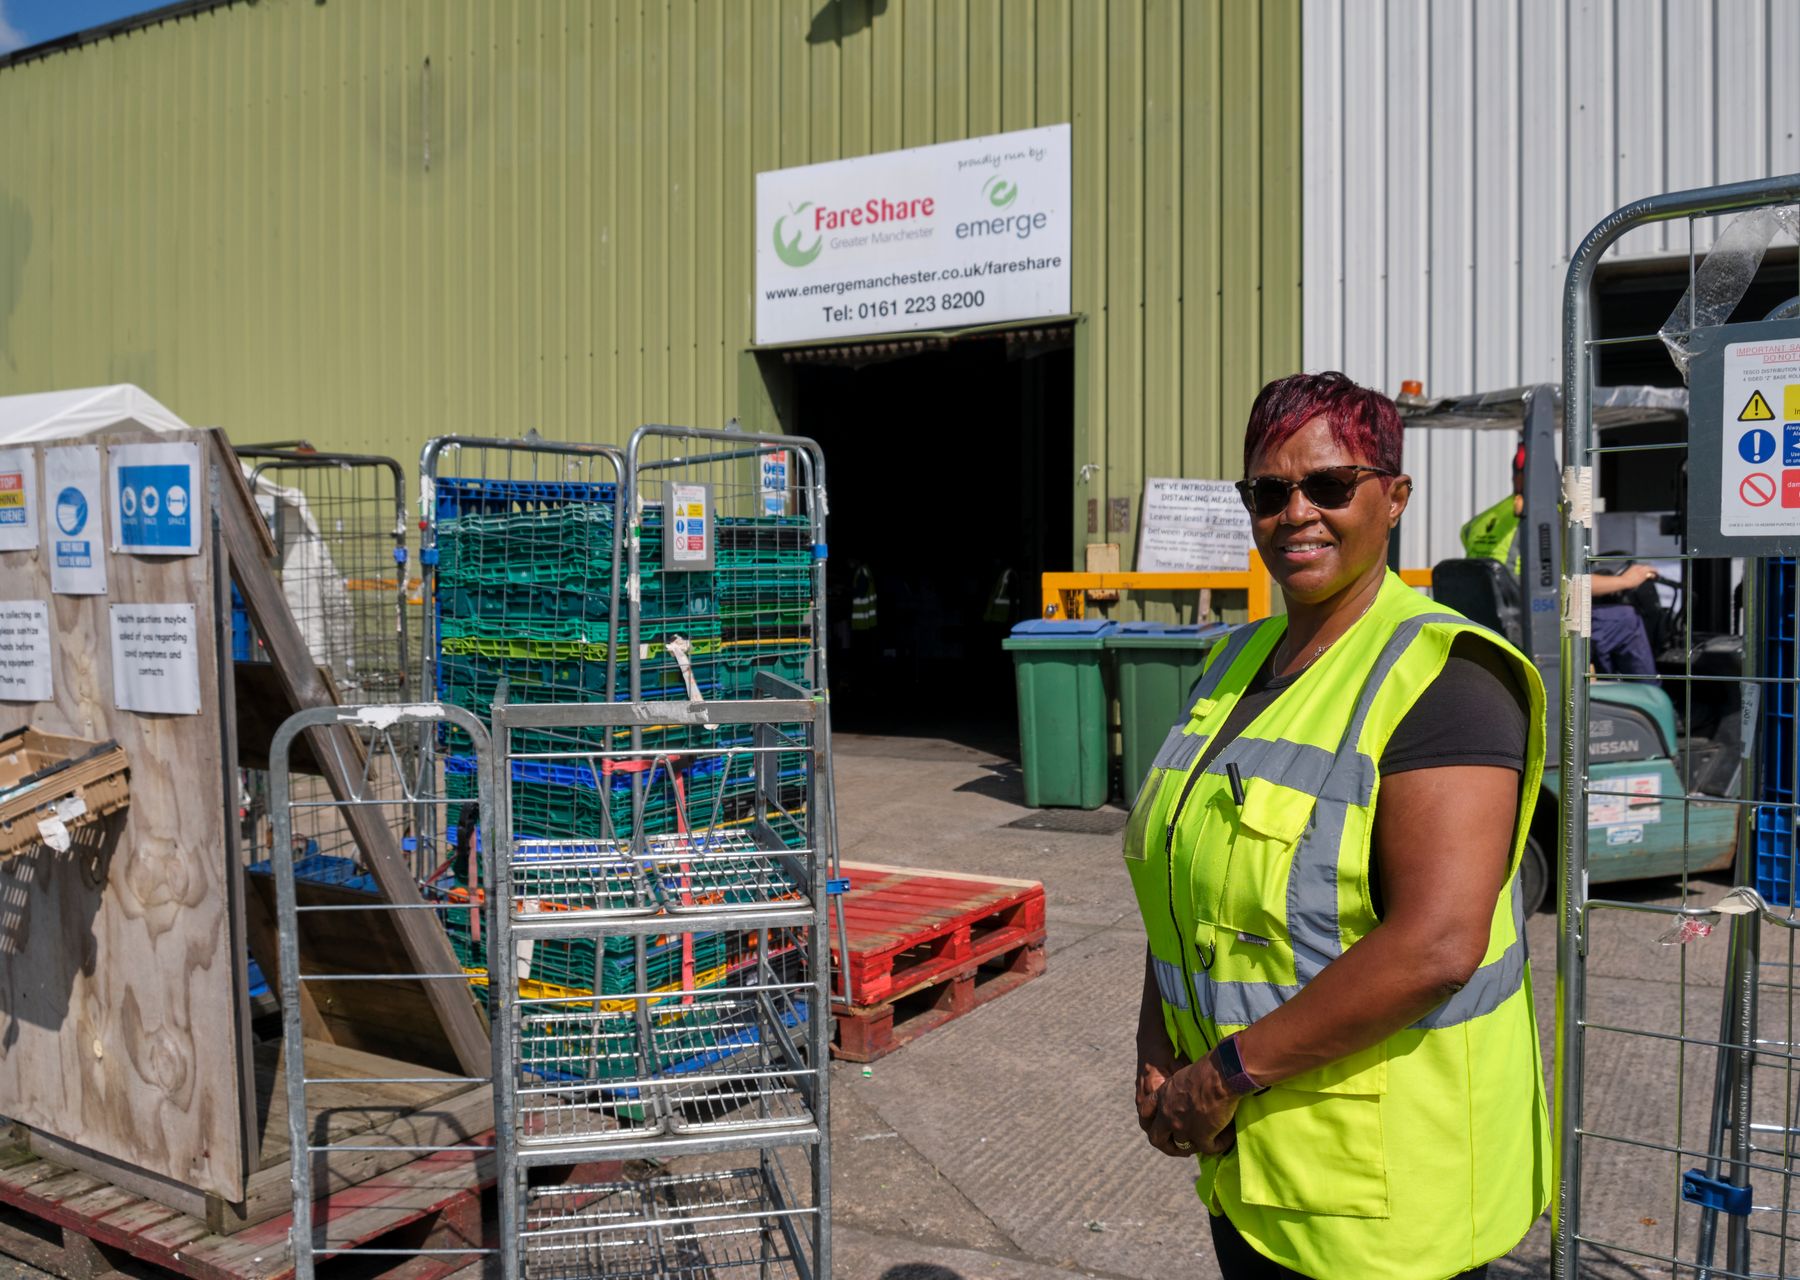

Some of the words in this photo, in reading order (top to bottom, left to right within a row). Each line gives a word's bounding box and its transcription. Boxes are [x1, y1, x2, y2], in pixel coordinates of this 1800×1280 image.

[957, 154, 1001, 171] proudly
[1004, 151, 1025, 164] run
[814, 197, 935, 231] FareShare
[955, 212, 1047, 239] emerge
[830, 234, 869, 250] Greater
[871, 226, 934, 246] Manchester
[765, 255, 1062, 300] www.emergemanchester.co.uk/fareshare
[822, 305, 853, 323] Tel:
[858, 300, 899, 319] 0161
[904, 295, 937, 315] 223
[941, 290, 985, 310] 8200
[1736, 344, 1788, 355] IMPORTANT
[1778, 353, 1796, 361] NOT
[1181, 482, 1233, 493] INTRODUCED
[1161, 494, 1209, 503] DISTANCING
[1149, 513, 1171, 521] Leave
[1184, 514, 1202, 522] least
[1147, 527, 1180, 536] between
[1183, 528, 1214, 539] yourself
[1215, 530, 1231, 539] and
[164, 614, 187, 626] maybe
[143, 634, 154, 643] you
[154, 632, 187, 644] regarding
[15, 641, 34, 651] before
[169, 649, 182, 659] and
[8, 659, 34, 668] equipment
[15, 677, 26, 686] you
[1589, 739, 1639, 756] NISSAN
